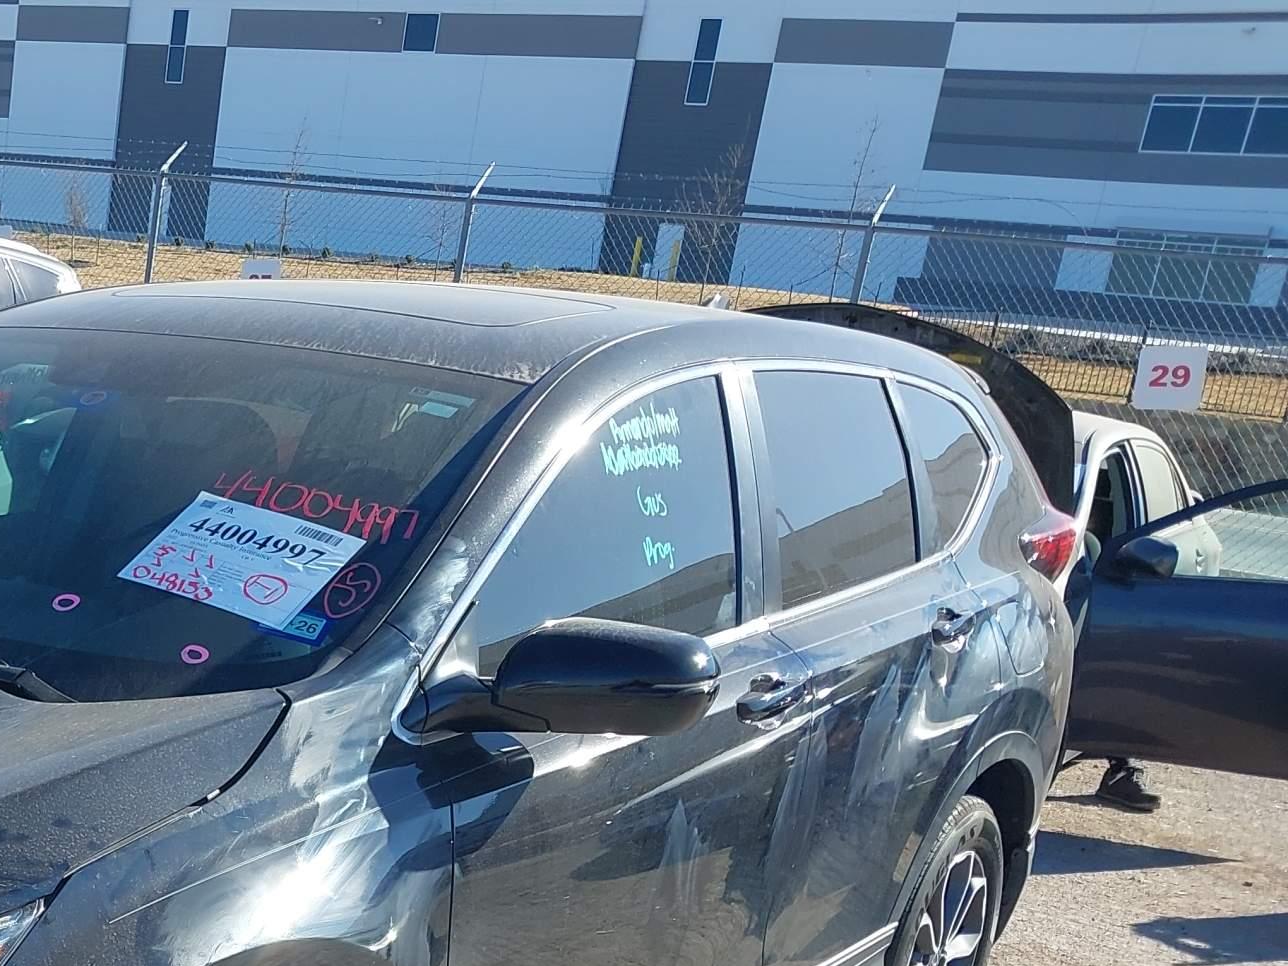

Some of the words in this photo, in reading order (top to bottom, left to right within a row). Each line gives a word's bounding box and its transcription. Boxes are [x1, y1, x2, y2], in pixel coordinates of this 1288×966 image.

[1149, 365, 1191, 388] 29
[215, 470, 420, 545] 44004997
[189, 515, 328, 565] 44004997
